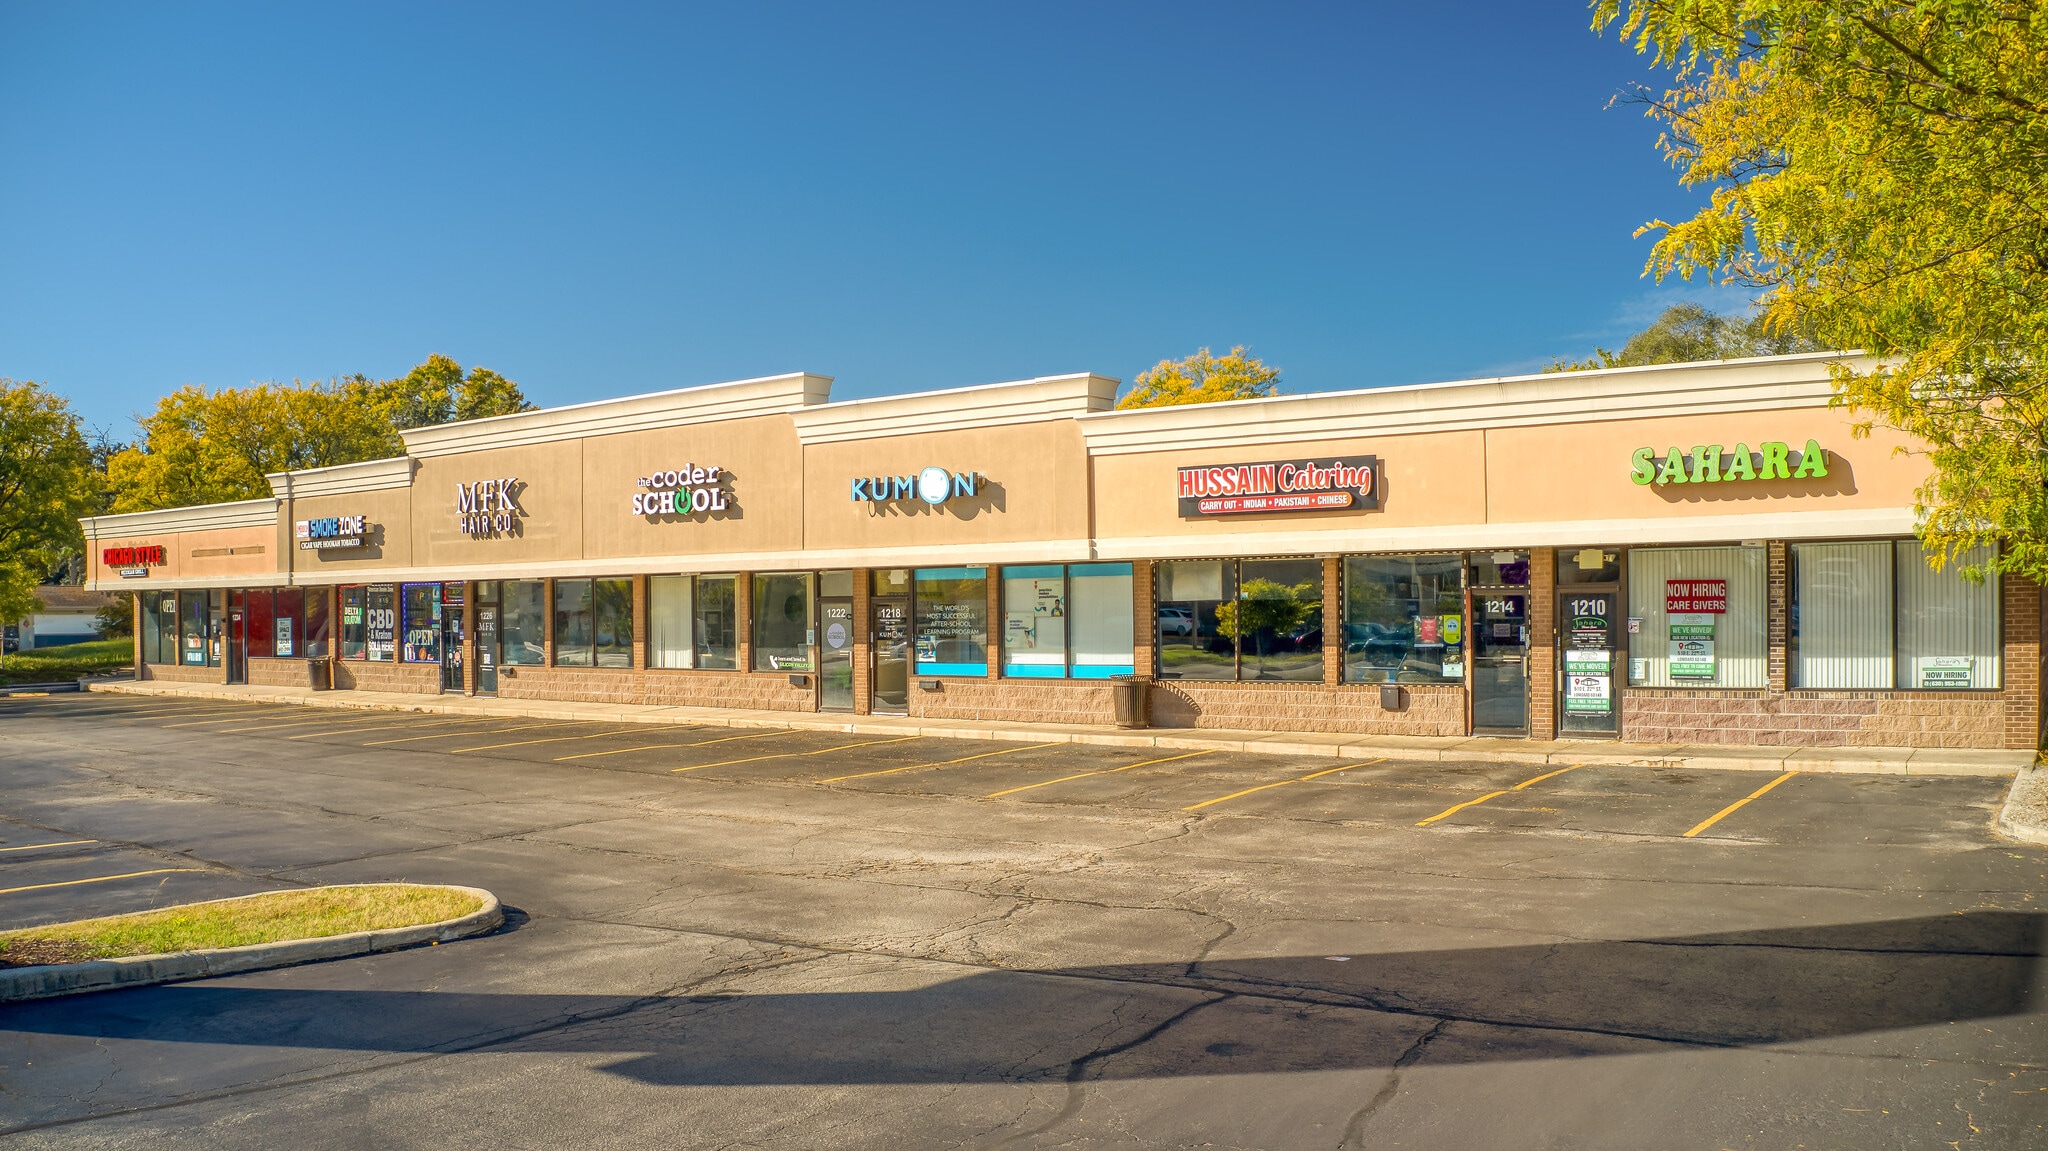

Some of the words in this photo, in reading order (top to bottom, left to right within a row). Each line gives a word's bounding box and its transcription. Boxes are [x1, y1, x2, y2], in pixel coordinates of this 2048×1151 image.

[1631, 439, 1828, 485] SAHARA
[637, 478, 651, 487] the
[652, 462, 720, 488] coder
[1179, 464, 1276, 498] HUSSAIN
[1278, 461, 1371, 496] Catering
[851, 466, 975, 505] KUMON
[456, 477, 518, 514] MFK
[632, 486, 725, 515] SCHOOL
[1200, 501, 1223, 510] CARRY
[1224, 500, 1237, 509] OUT
[1243, 498, 1266, 508] INDIAN
[1274, 496, 1310, 506] PAKISTANI
[1317, 494, 1347, 505] CHINESE
[310, 517, 339, 538] SMOKE
[339, 515, 363, 536] ZONE
[461, 515, 489, 534] HAIR
[496, 513, 511, 531] CO
[301, 541, 313, 550] CIGAR
[313, 541, 323, 549] VAPE
[341, 537, 360, 547] TOBACCO
[103, 547, 133, 565] CHICAGO
[135, 545, 161, 564] STYLE
[1667, 584, 1690, 597] NOW
[1692, 583, 1726, 597] HIRING
[344, 607, 358, 616] DELTA
[826, 608, 846, 618] 1222
[881, 608, 901, 618] 1218
[1484, 600, 1515, 612] 1214
[1571, 600, 1606, 616] 1210
[1667, 601, 1690, 610] CARE
[1692, 600, 1726, 610] GIVERS
[368, 608, 394, 629] CBD
[409, 630, 434, 646] OPEN
